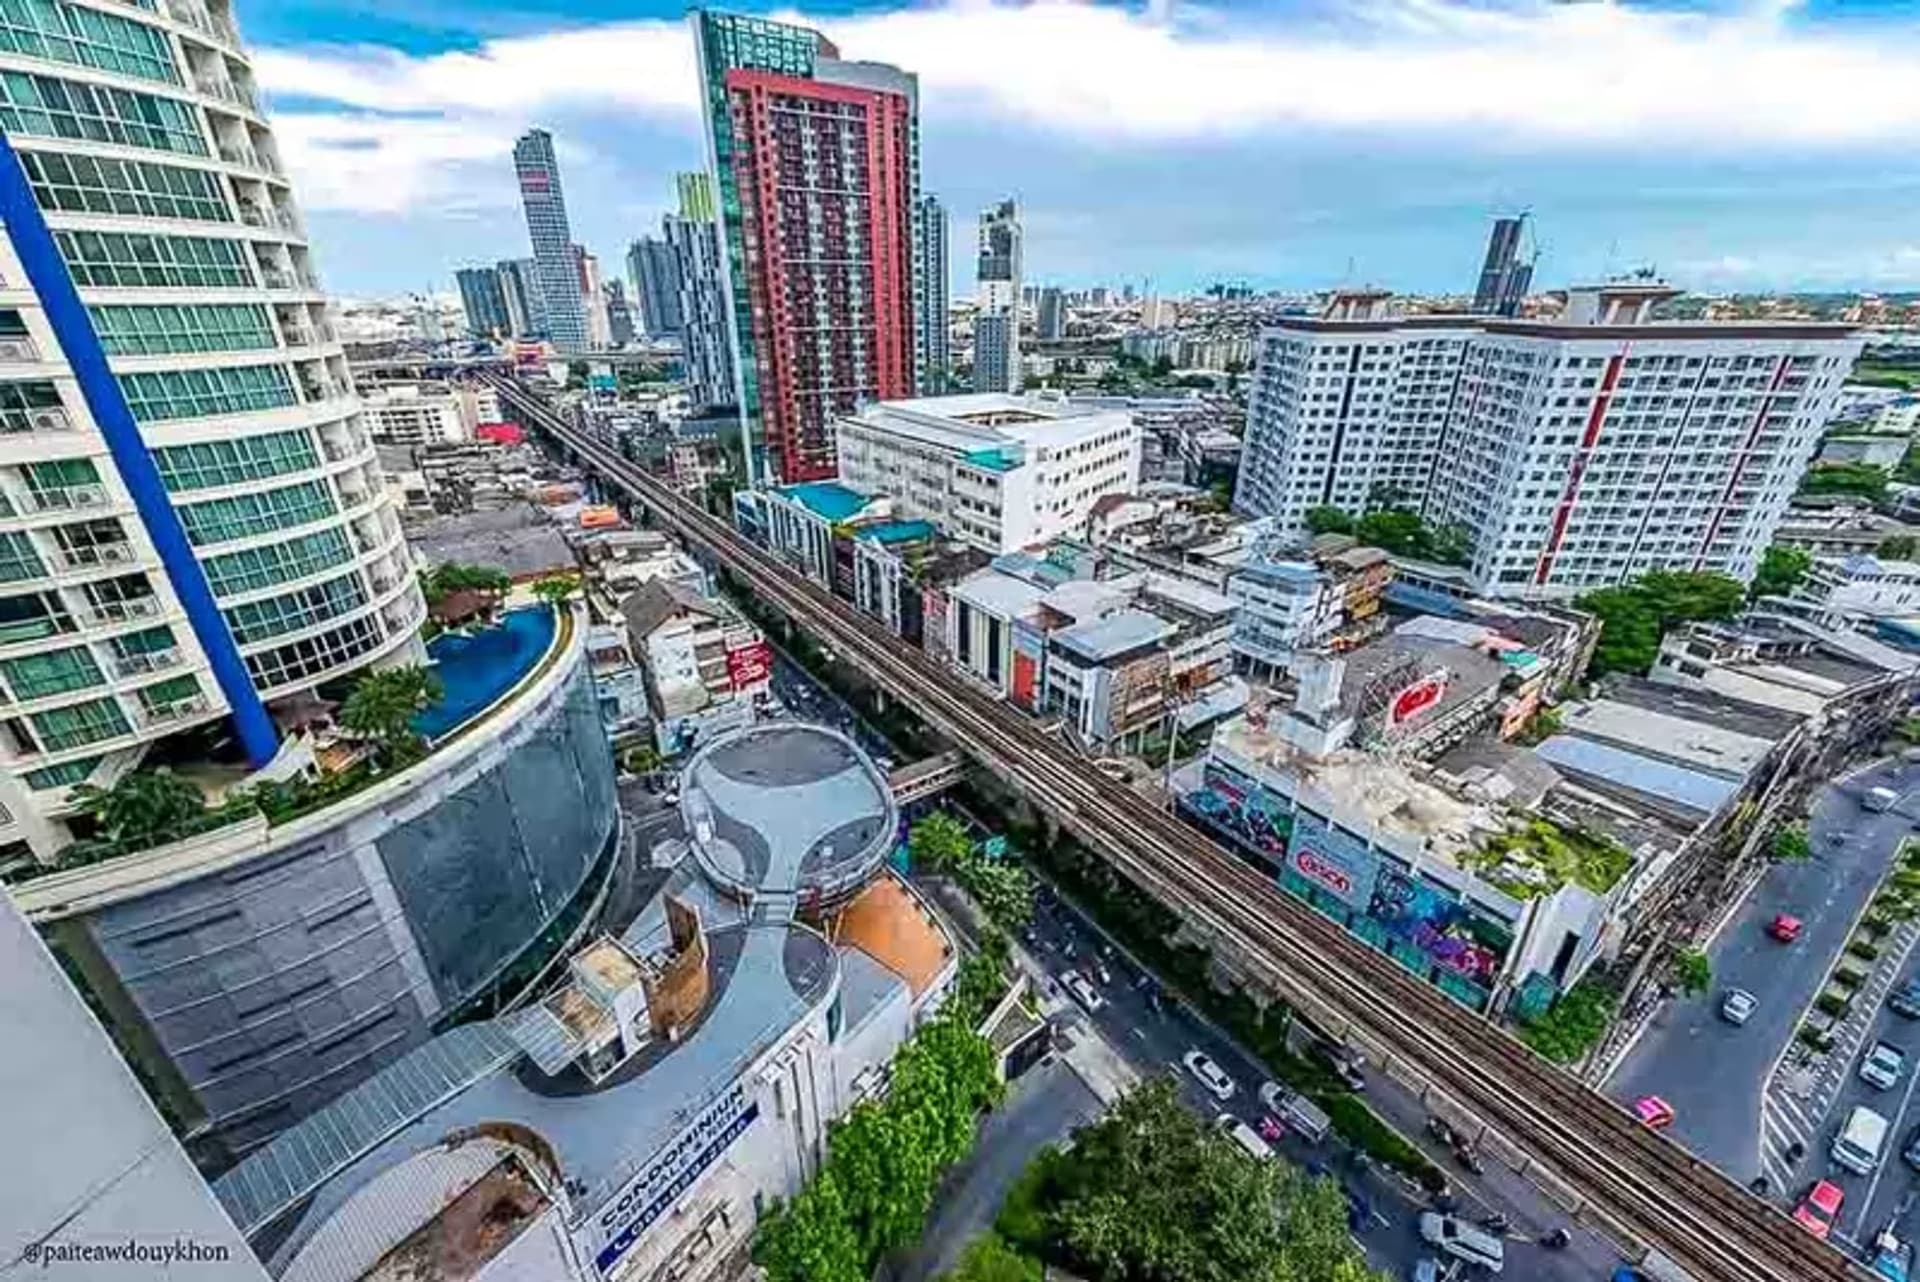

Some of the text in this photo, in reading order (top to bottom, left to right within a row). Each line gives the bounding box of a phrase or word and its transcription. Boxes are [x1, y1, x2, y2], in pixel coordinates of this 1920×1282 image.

[601, 1083, 745, 1227] CONDOMINIUM
[604, 1200, 644, 1239] FOR
[648, 1154, 692, 1197] SALE
[706, 1100, 745, 1139] RENT
